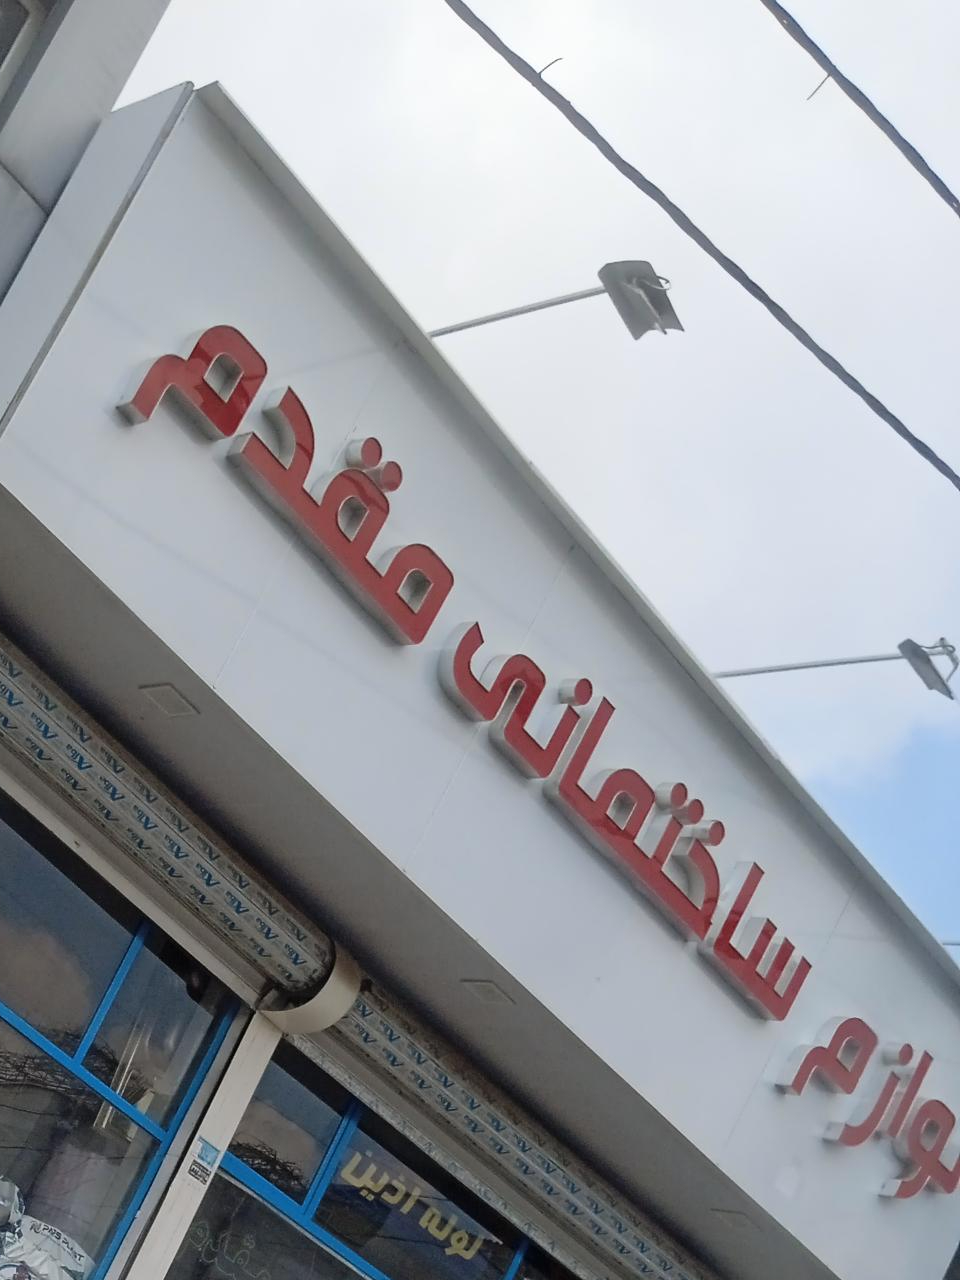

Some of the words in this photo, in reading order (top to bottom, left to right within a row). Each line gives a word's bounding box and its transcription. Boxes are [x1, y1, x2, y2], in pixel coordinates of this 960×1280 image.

[122, 324, 454, 643] مقدم
[29, 710, 59, 739] Alba
[64, 742, 93, 770] Alba
[444, 622, 812, 1021] ساختمانی
[418, 1206, 485, 1260] لوله
